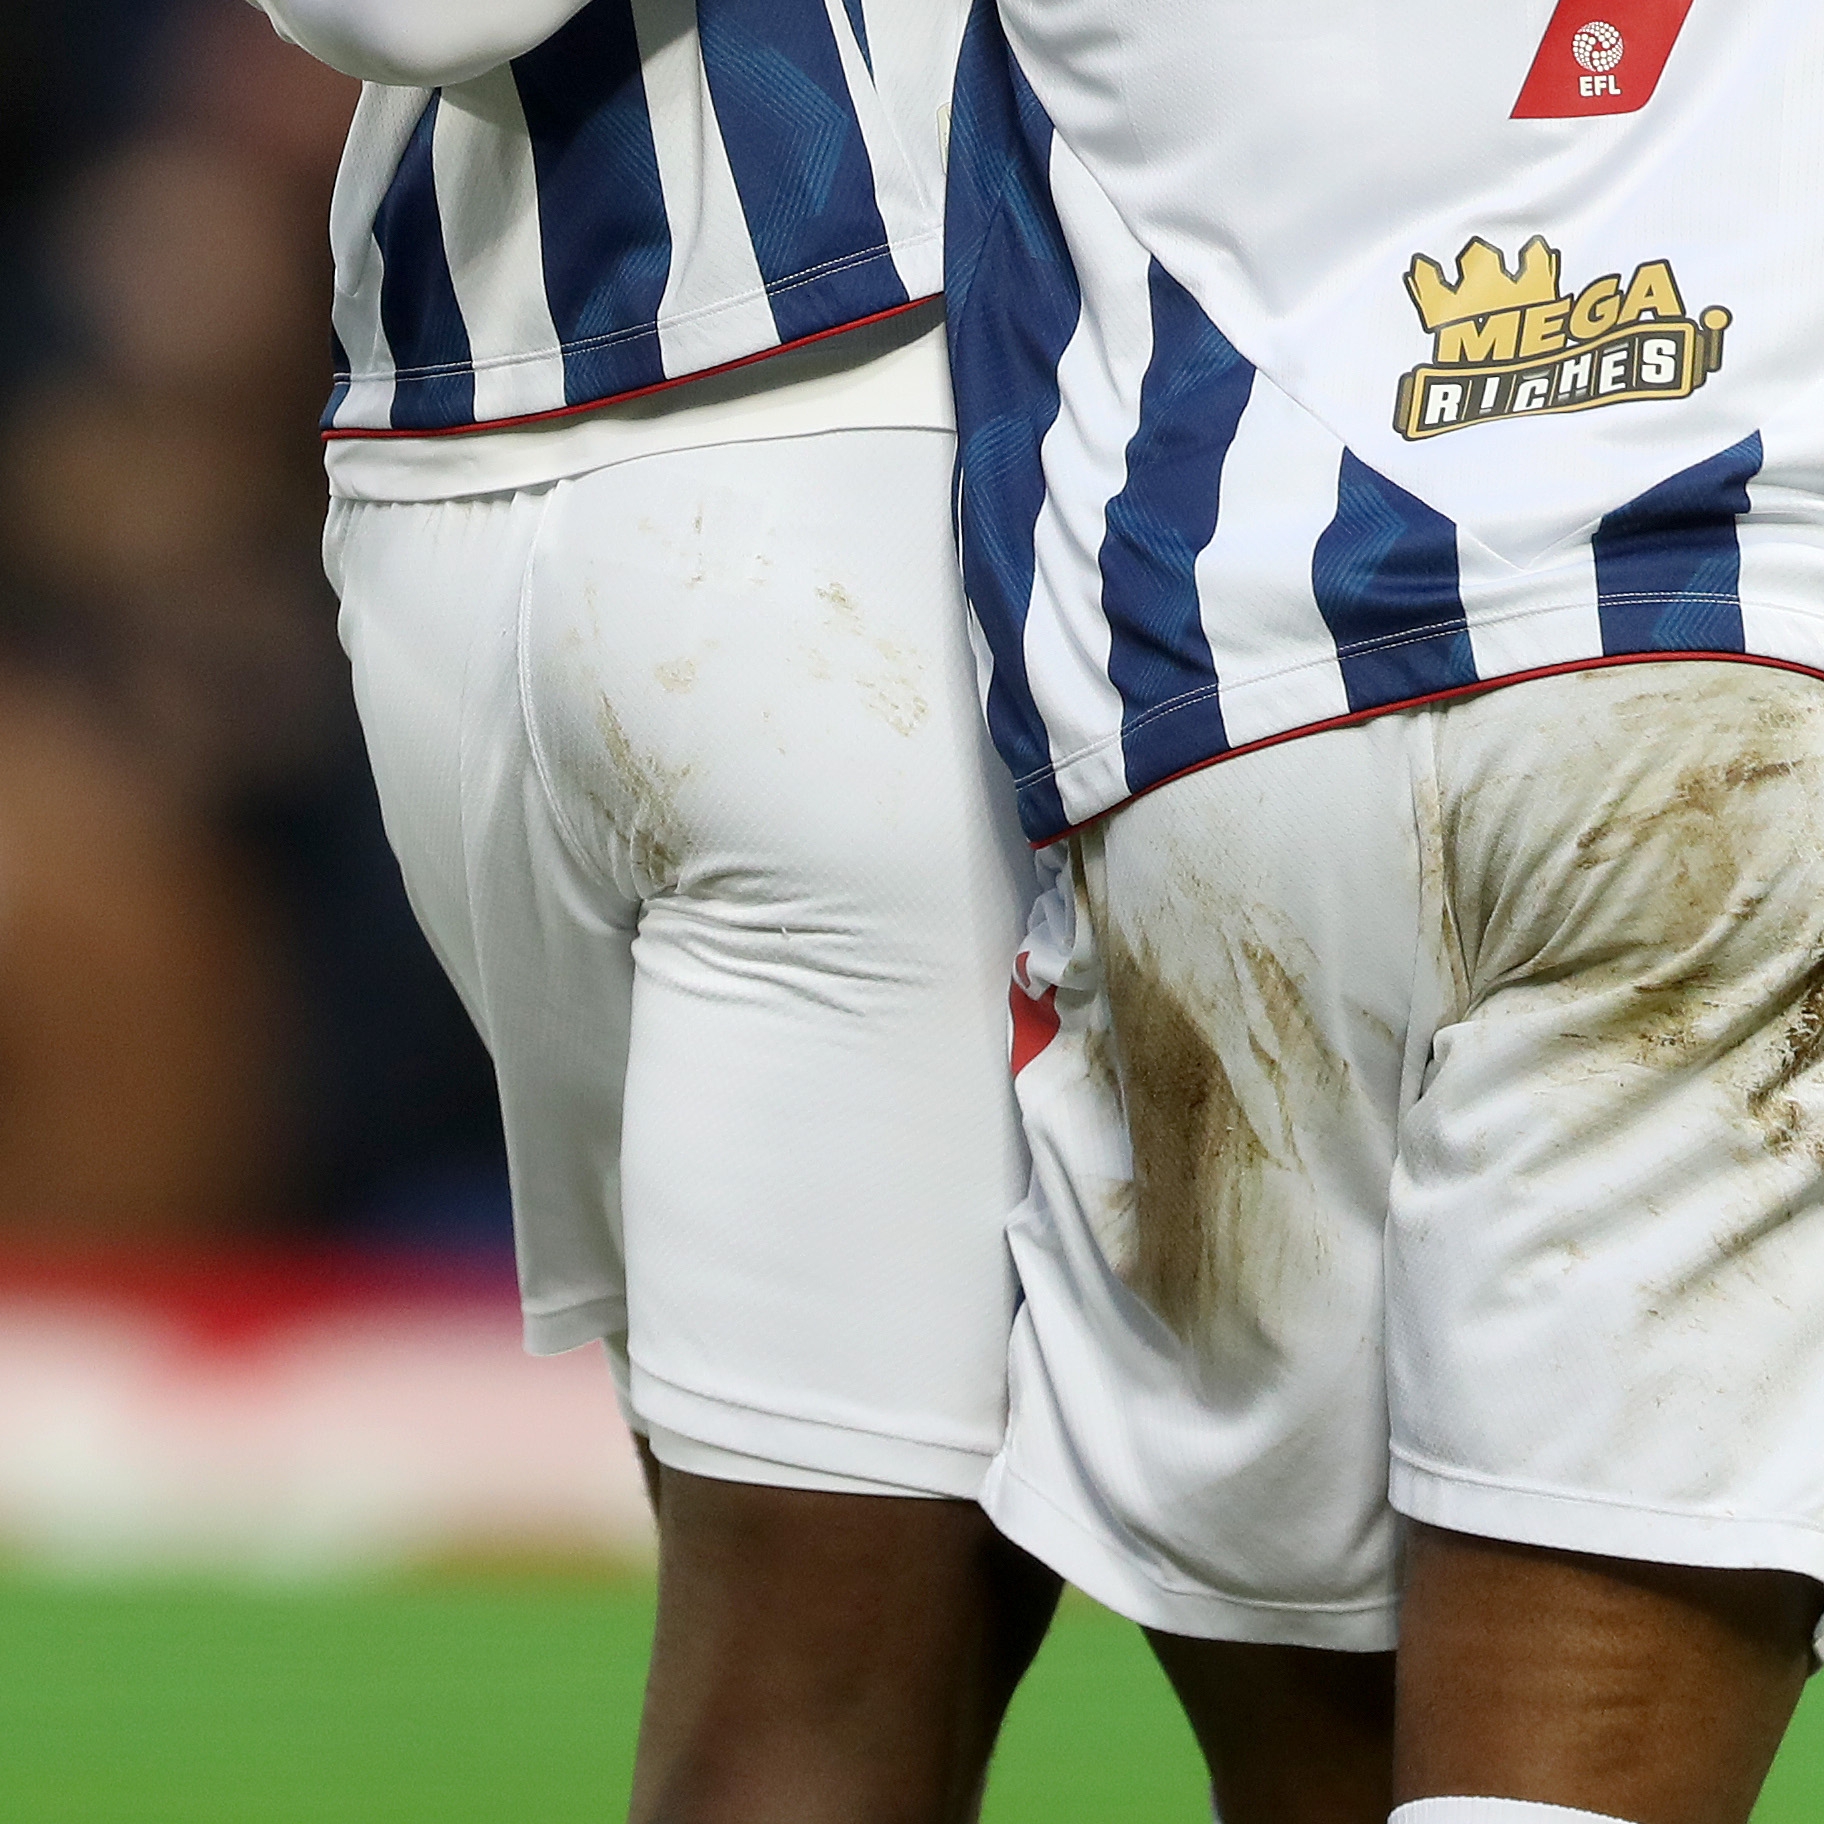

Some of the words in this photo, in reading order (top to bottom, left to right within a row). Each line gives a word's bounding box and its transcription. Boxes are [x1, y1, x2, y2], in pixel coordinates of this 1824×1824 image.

[1578, 74, 1622, 97] EFL
[1435, 261, 1685, 364] MEGA
[1423, 337, 1677, 426] RICHES
